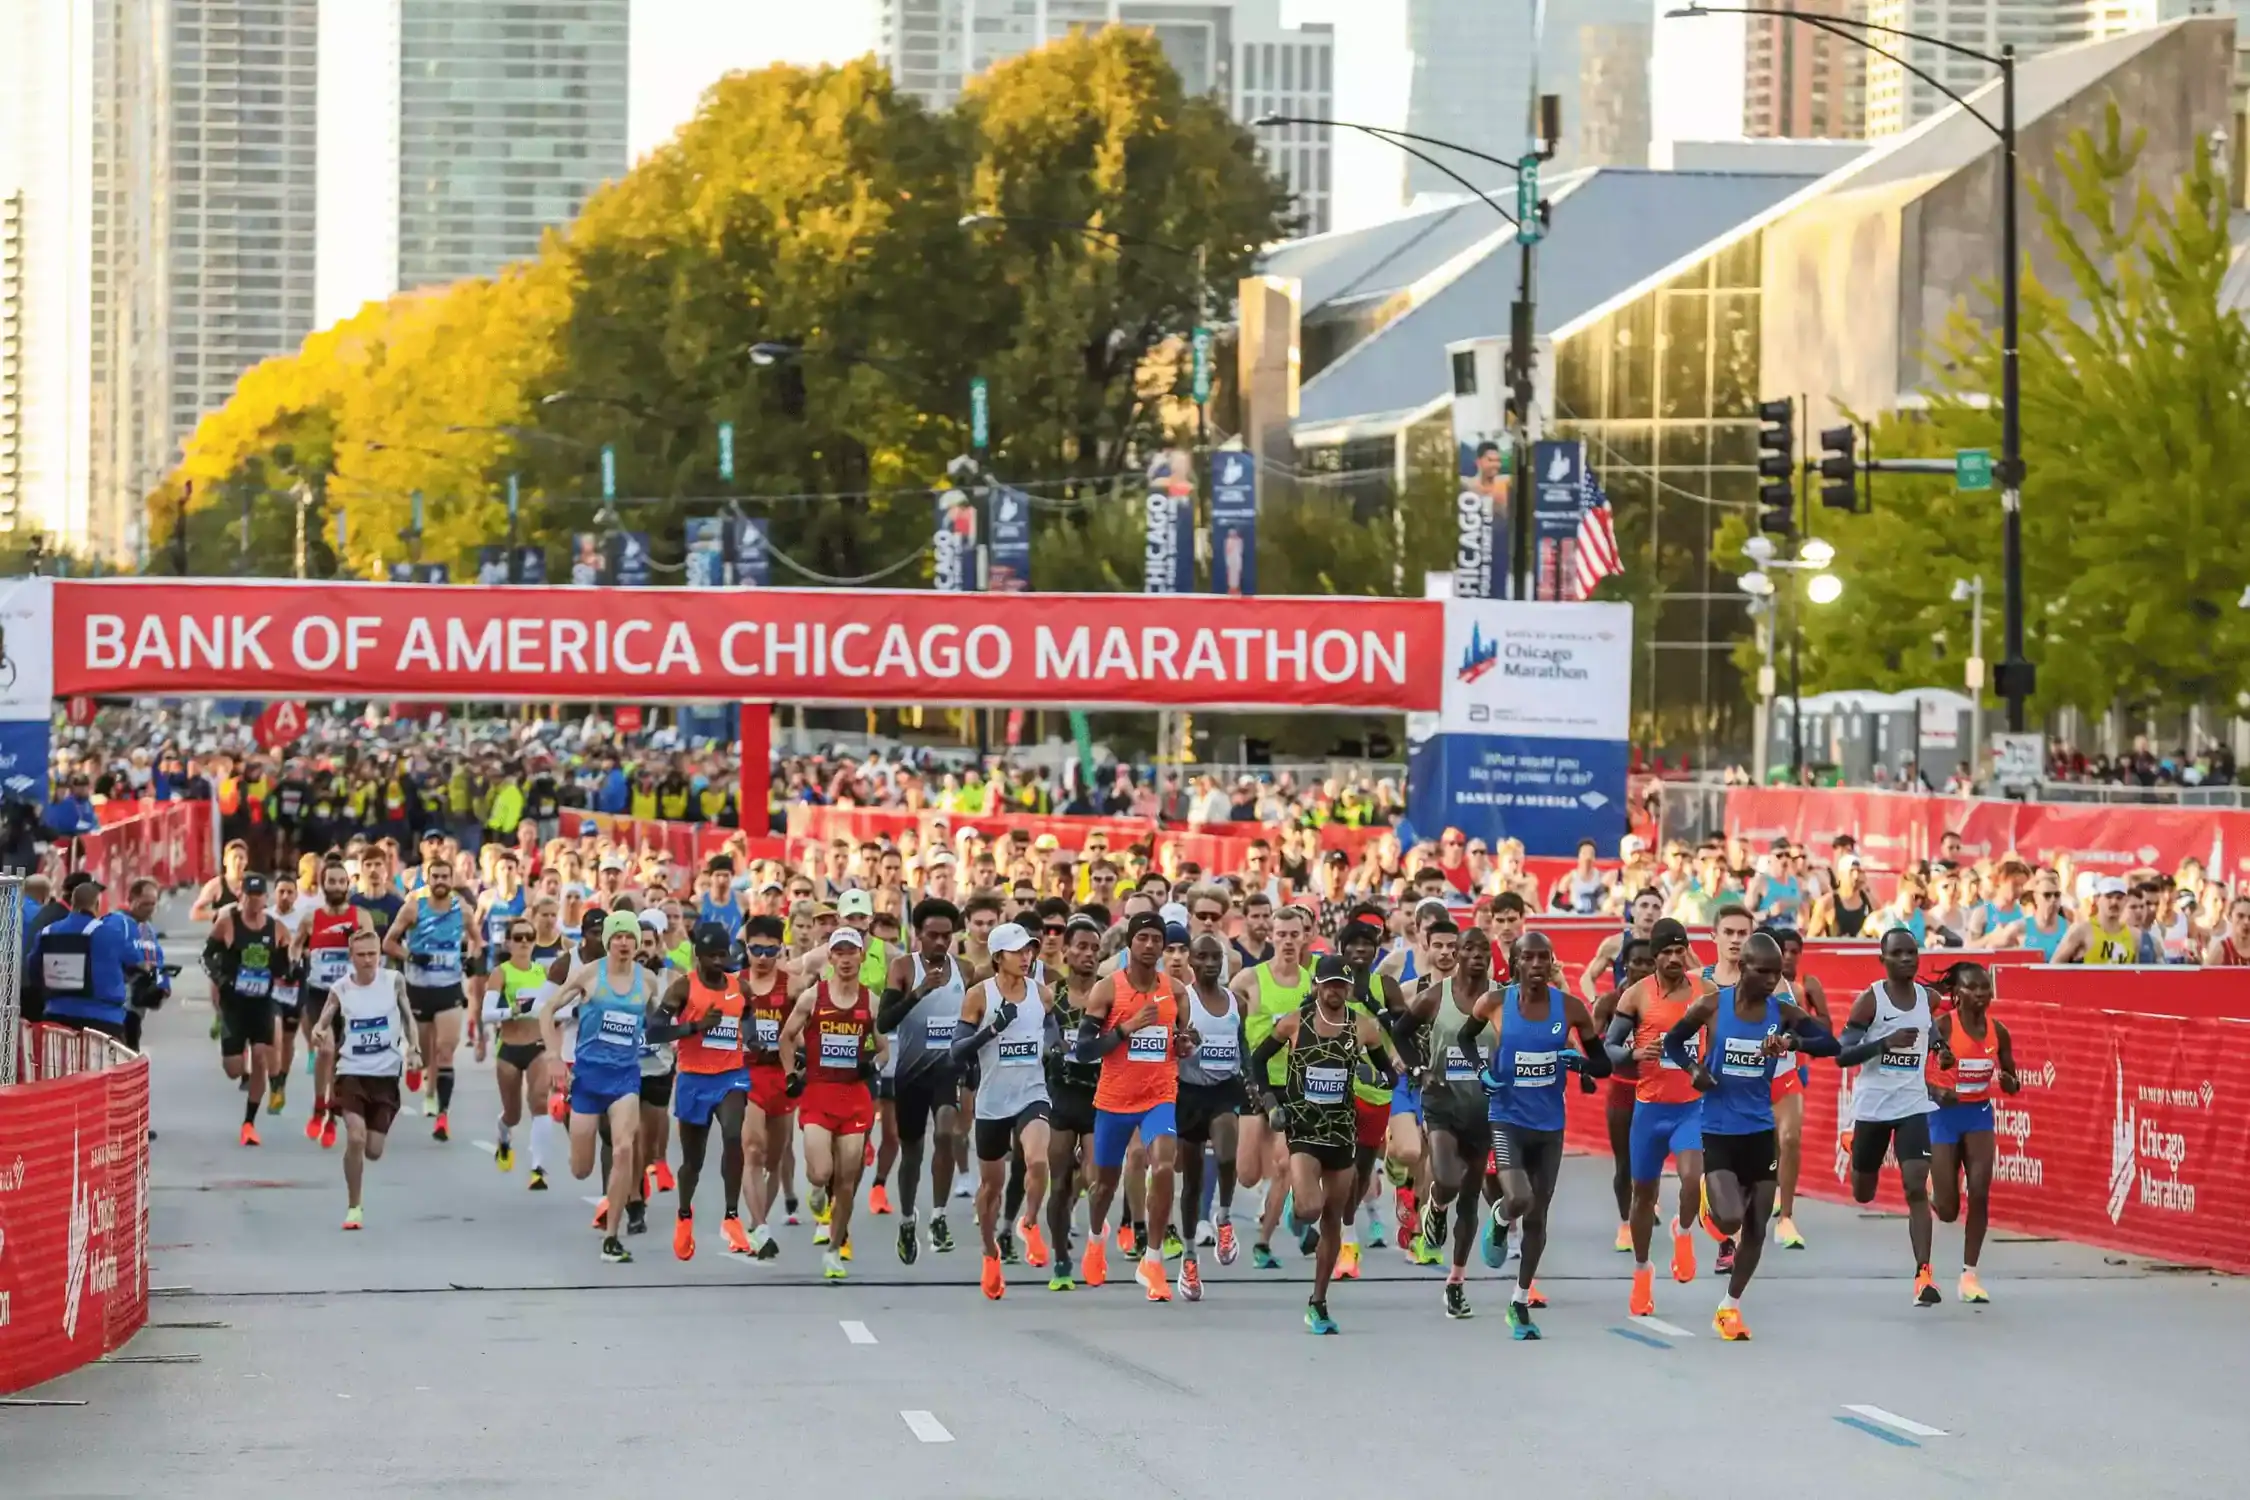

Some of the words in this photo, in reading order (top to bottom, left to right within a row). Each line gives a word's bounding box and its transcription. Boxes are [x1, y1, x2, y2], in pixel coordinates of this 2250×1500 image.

[84, 614, 273, 670] BANK
[291, 615, 382, 670] OF
[394, 617, 702, 675] AMERICA
[719, 621, 1012, 680] CHICAGO
[1034, 625, 1407, 684] MARATHON
[1504, 643, 1573, 663] Chicago
[1504, 663, 1588, 680] Marathon
[275, 701, 298, 731] A
[1456, 792, 1495, 804] BANK
[1496, 793, 1513, 805] OF
[1515, 795, 1578, 808] AMERICA
[602, 1022, 634, 1034] HOGAN
[820, 1021, 863, 1037] CHINA
[361, 1033, 380, 1044] 575
[1131, 1038, 1166, 1050] DEGU
[822, 1046, 857, 1057] DONG
[1001, 1044, 1027, 1055] PACE
[1030, 1042, 1037, 1053] 4
[1203, 1048, 1236, 1058] KOECH
[1725, 1053, 1755, 1065] PACE
[1757, 1055, 1765, 1066] 2
[1883, 1054, 1911, 1066] PACE
[1913, 1055, 1919, 1066] 7
[1516, 1066, 1547, 1076] PACE
[1549, 1065, 1556, 1074] 3
[1307, 1080, 1345, 1092] YIMER
[2165, 1089, 2199, 1108] AMERICA
[1990, 1097, 2030, 1148] hicago
[2140, 1118, 2185, 1172] Chicago
[2140, 1166, 2195, 1213] Marathon
